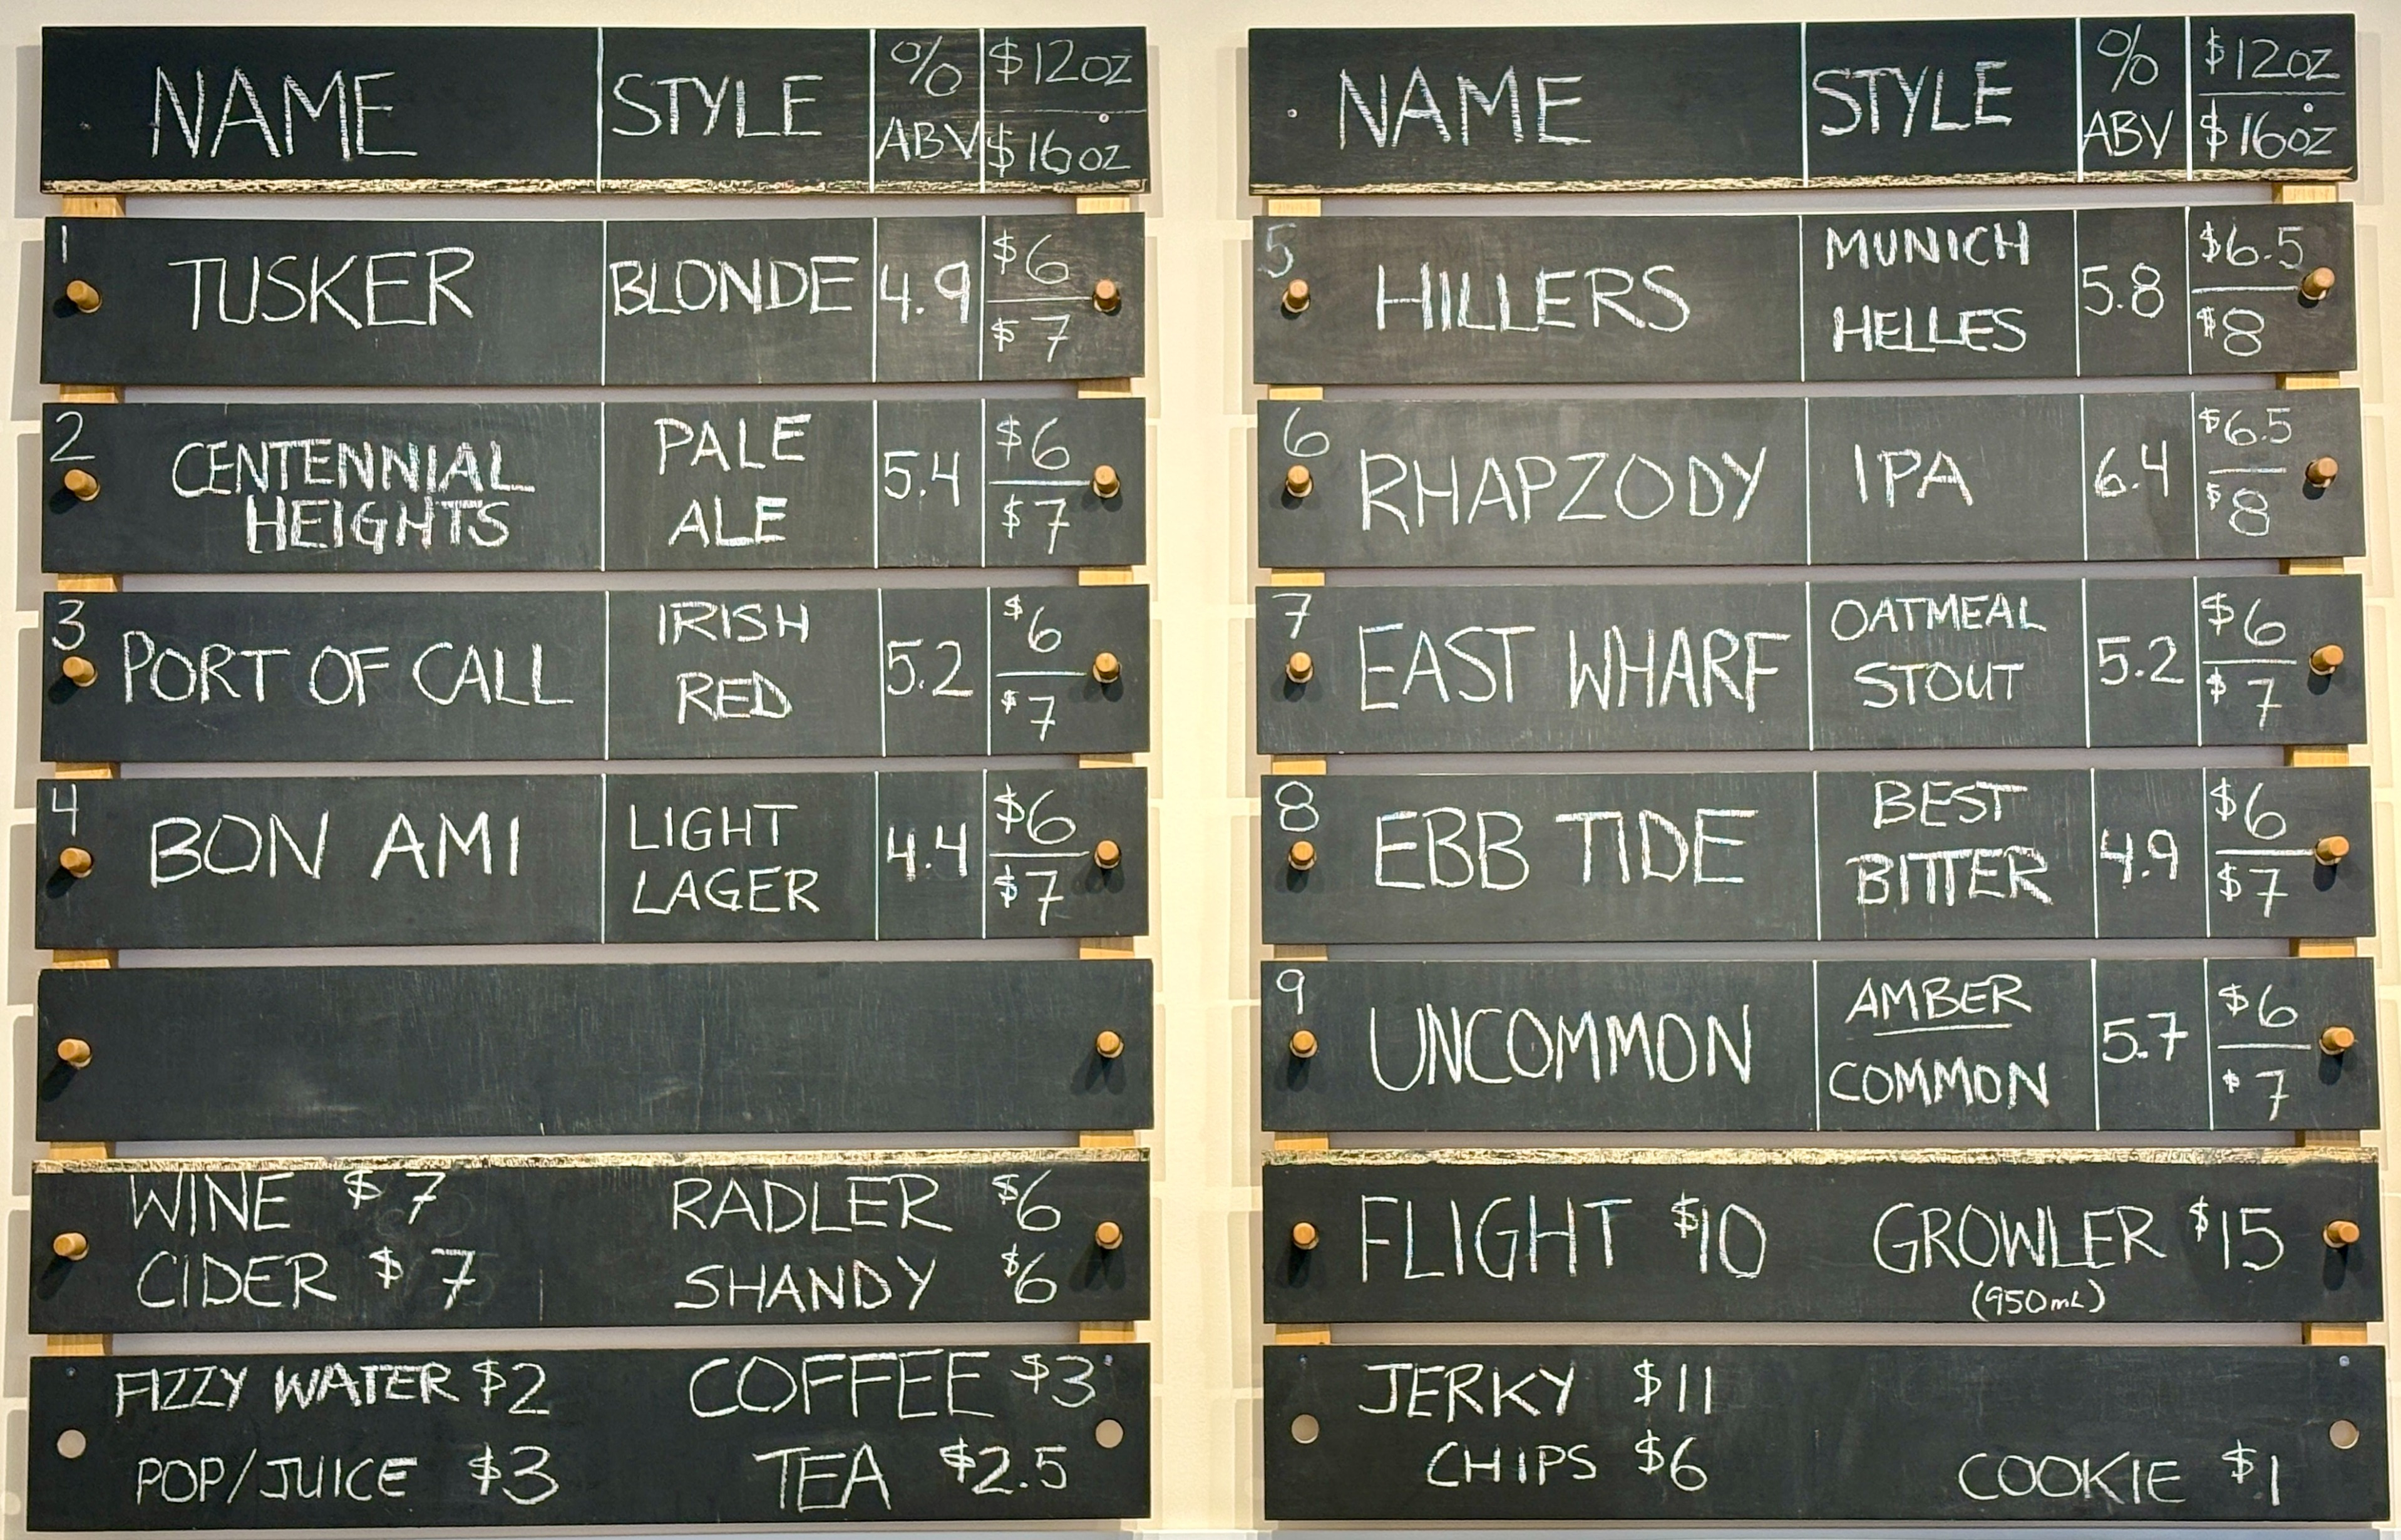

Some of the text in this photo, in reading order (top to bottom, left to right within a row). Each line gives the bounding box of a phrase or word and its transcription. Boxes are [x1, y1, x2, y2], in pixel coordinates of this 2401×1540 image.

[891, 35, 962, 96] %
[2097, 24, 2159, 93] %
[152, 66, 418, 160] NAME
[612, 73, 824, 138] STYLE
[1339, 66, 1592, 150] NAME
[1812, 59, 2013, 137] STYLE
[875, 116, 980, 162] ABV
[2081, 109, 2174, 160] ABV
[61, 225, 68, 263] 1
[993, 230, 1070, 285] $6
[1257, 223, 1296, 279] 5
[1827, 219, 2030, 270] MUNICH
[2199, 220, 2305, 270] $6.5
[168, 247, 475, 330] TUSKER
[609, 255, 860, 316] BLONDE
[880, 260, 970, 324] 4.9
[1377, 262, 1690, 333] HILLERS
[2081, 262, 2165, 319] 5.8
[991, 314, 1071, 362] $7
[1833, 304, 2026, 354] HELLES
[2197, 306, 2265, 357] $8
[49, 411, 95, 463] 2
[654, 413, 811, 475] PALE
[996, 414, 1070, 471] $6
[1283, 407, 1330, 458] 6
[2199, 406, 2293, 446] $6.5
[172, 438, 535, 499] CENTENNIAL
[884, 450, 960, 506] 5.4
[1360, 446, 1767, 535] RHAPZODY
[1854, 444, 1973, 508] IPA
[2095, 439, 2169, 499] 6.4
[246, 494, 510, 554] HEIGHTS
[669, 496, 788, 547] ALE
[1002, 494, 1070, 555] $7
[2206, 483, 2270, 536] $8
[51, 600, 86, 651] 3
[659, 600, 810, 645] IRISH
[1004, 594, 1062, 653] $6
[1271, 593, 1312, 639] 7
[1831, 593, 2047, 641] OATMEAL
[2201, 592, 2287, 647] $6
[122, 630, 573, 707] PORT OF CALL
[887, 639, 974, 696] 5.2
[1359, 623, 1791, 713] EAST WHARF
[1853, 661, 2024, 709] STOUT
[2097, 635, 2185, 686] 5.2
[677, 671, 793, 724] RED
[1002, 690, 1056, 742] $7
[2206, 667, 2282, 731] $7
[51, 784, 80, 837] 4
[629, 804, 798, 851] LIGHT
[994, 784, 1077, 845] $6
[1275, 781, 1319, 832] 8
[1874, 780, 2028, 828] BEST
[2209, 777, 2287, 840] $6
[151, 810, 520, 888] BON AMI
[887, 823, 967, 882] 4.4
[1374, 807, 1759, 891] EBB TIDE
[1846, 845, 2054, 907] BITTER
[2100, 828, 2178, 891] 4.9
[633, 866, 820, 914] LAGER
[993, 865, 1064, 926] $7
[2216, 862, 2288, 919] $7
[1276, 969, 1305, 1014] 9
[1845, 974, 2032, 1024] AMBER
[2218, 983, 2298, 1029] $6
[1370, 1004, 1751, 1092] UNCOMMON
[2102, 1011, 2188, 1065] 5.7
[1829, 1058, 2050, 1109] COMMON
[2223, 1069, 2290, 1122] $7
[129, 1170, 295, 1238] WINE
[673, 1169, 1061, 1234] RADLER $6
[1360, 1191, 1766, 1283] FLIGHT $10
[1873, 1195, 2285, 1274] GROWLER $15
[137, 1250, 337, 1310] CIDER
[674, 1244, 1057, 1313] SHANDY $6
[115, 1358, 550, 1419] FIZZY WATER $2
[689, 1348, 1096, 1419] COFFEE $3
[1358, 1358, 1712, 1424] JERKY $11
[137, 1443, 559, 1506] POP/JUICE $3
[753, 1437, 1069, 1512] TEA $2.5
[1426, 1429, 1708, 1492] CHIPS $6
[1958, 1439, 2281, 1506] COOKIE $1
